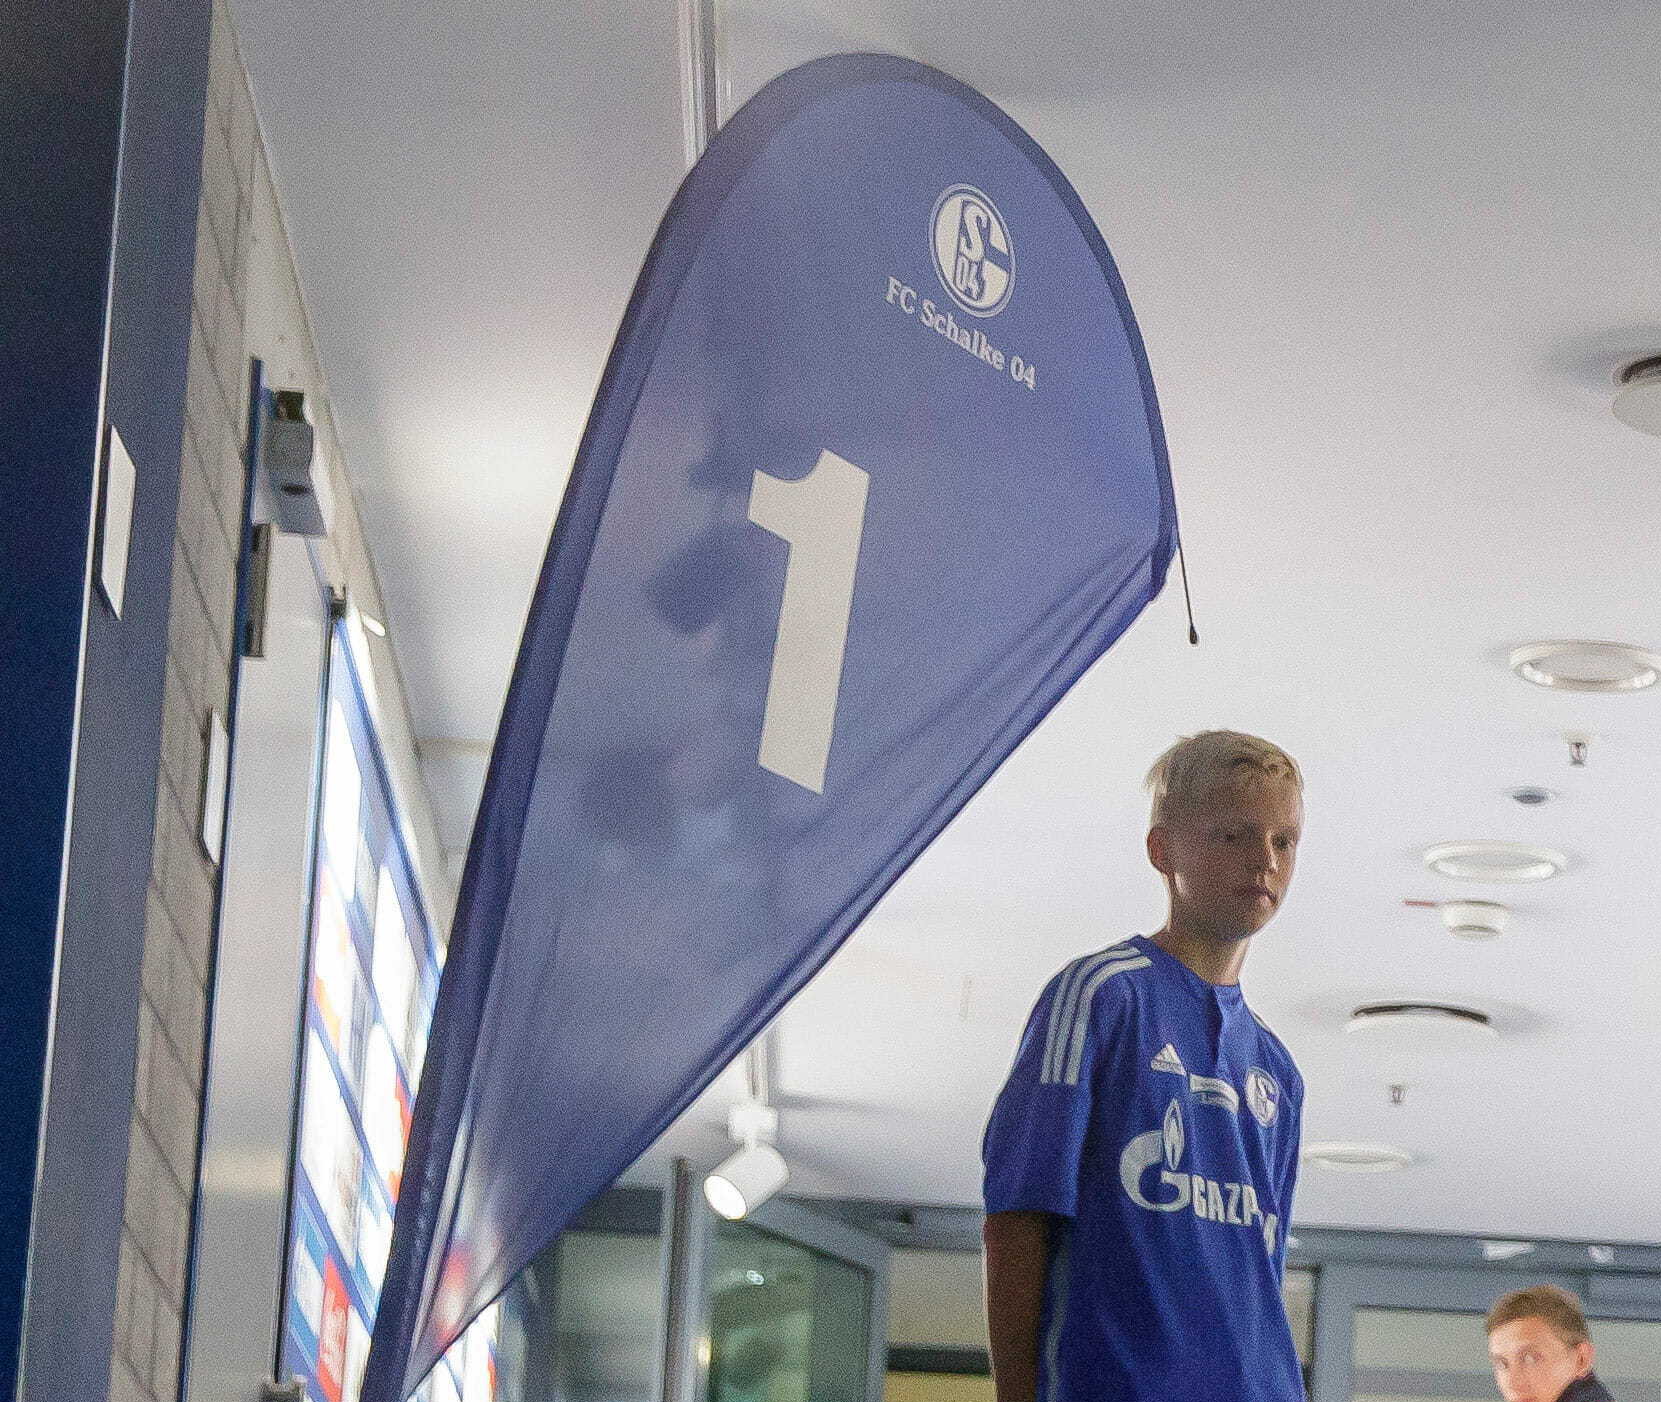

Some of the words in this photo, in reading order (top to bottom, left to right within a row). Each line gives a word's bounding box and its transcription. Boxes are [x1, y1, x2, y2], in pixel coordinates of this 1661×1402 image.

[885, 276, 917, 315] FC
[920, 299, 1006, 371] Schalke
[1010, 355, 1037, 391] 04
[747, 449, 870, 794] 1
